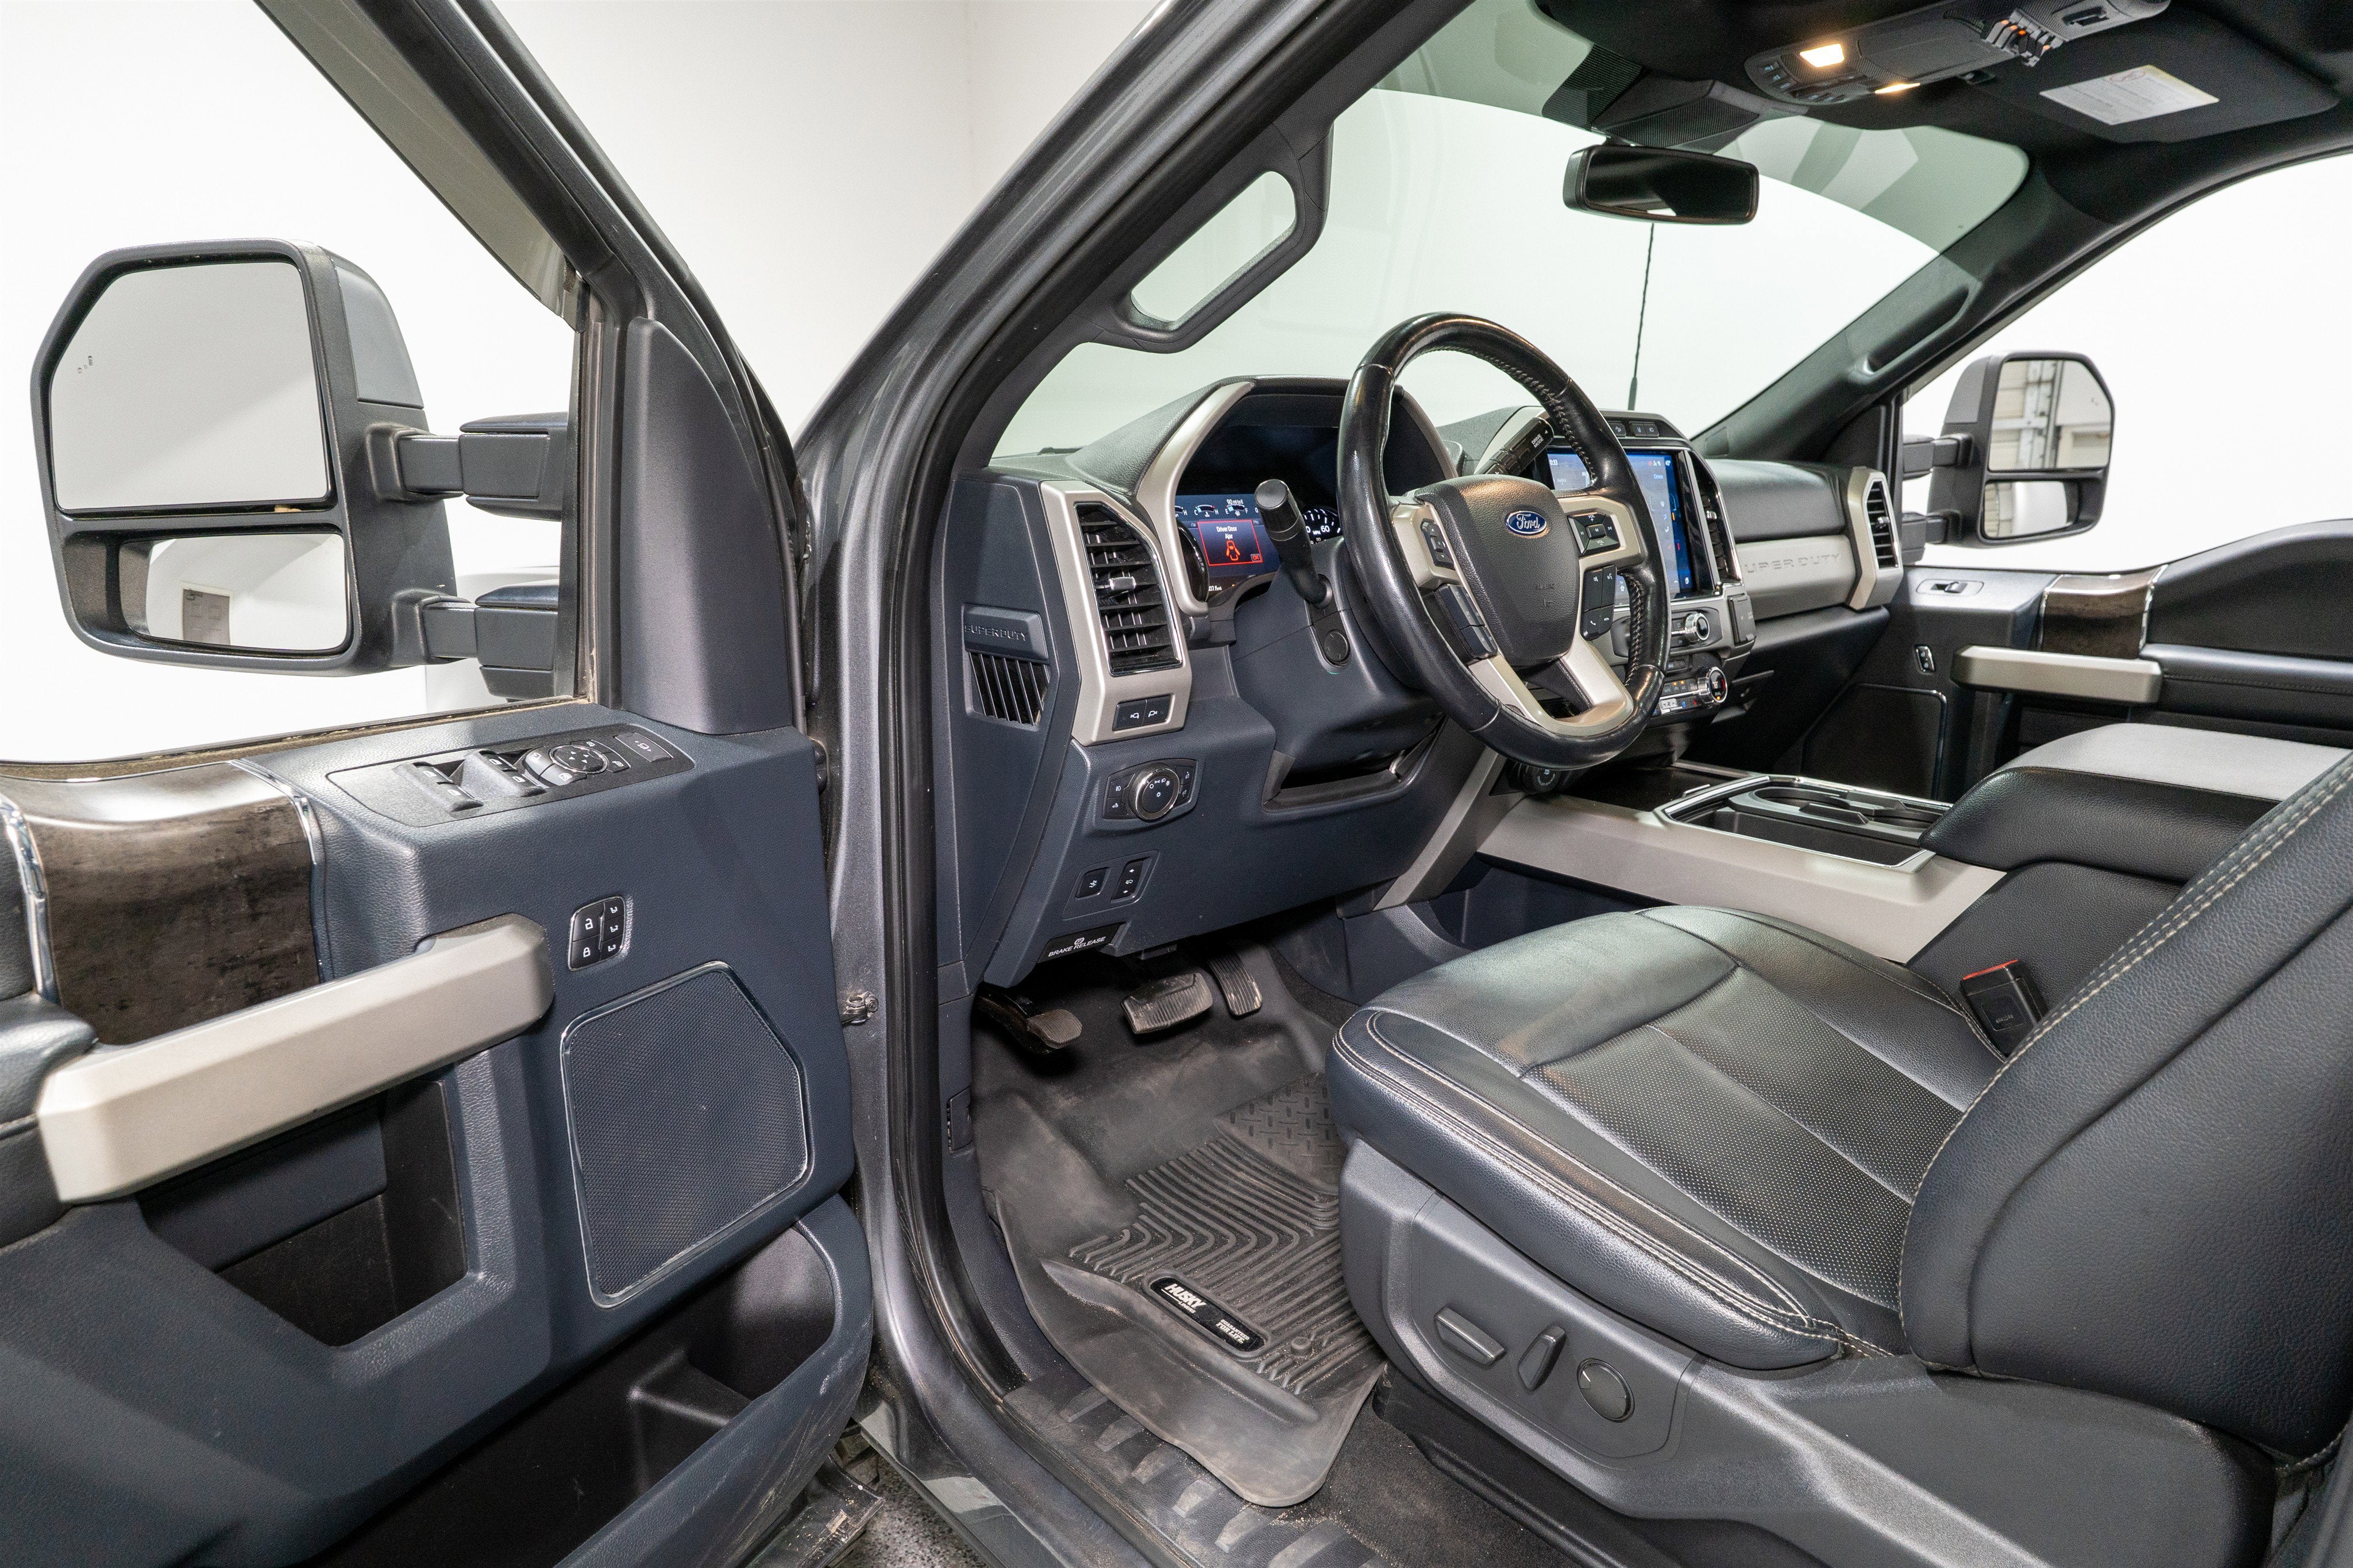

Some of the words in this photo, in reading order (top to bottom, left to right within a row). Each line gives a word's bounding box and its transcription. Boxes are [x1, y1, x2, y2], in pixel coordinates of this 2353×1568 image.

[1531, 433, 1541, 445] DRIVE
[1534, 437, 1544, 448] MODE
[1516, 513, 1540, 530] Ford
[1740, 559, 1794, 573] UPER
[1797, 553, 1839, 566] DUTY
[965, 624, 1000, 638] SUPER
[1000, 629, 1028, 641] DUTY
[1048, 946, 1073, 957] BRAKE
[1073, 936, 1106, 950] RELEASE
[1164, 1283, 1207, 1308] HUSKY
[1178, 1301, 1196, 1314] LINERS
[1215, 1322, 1231, 1333] FOR
[1220, 1319, 1250, 1341] GUARANTEED
